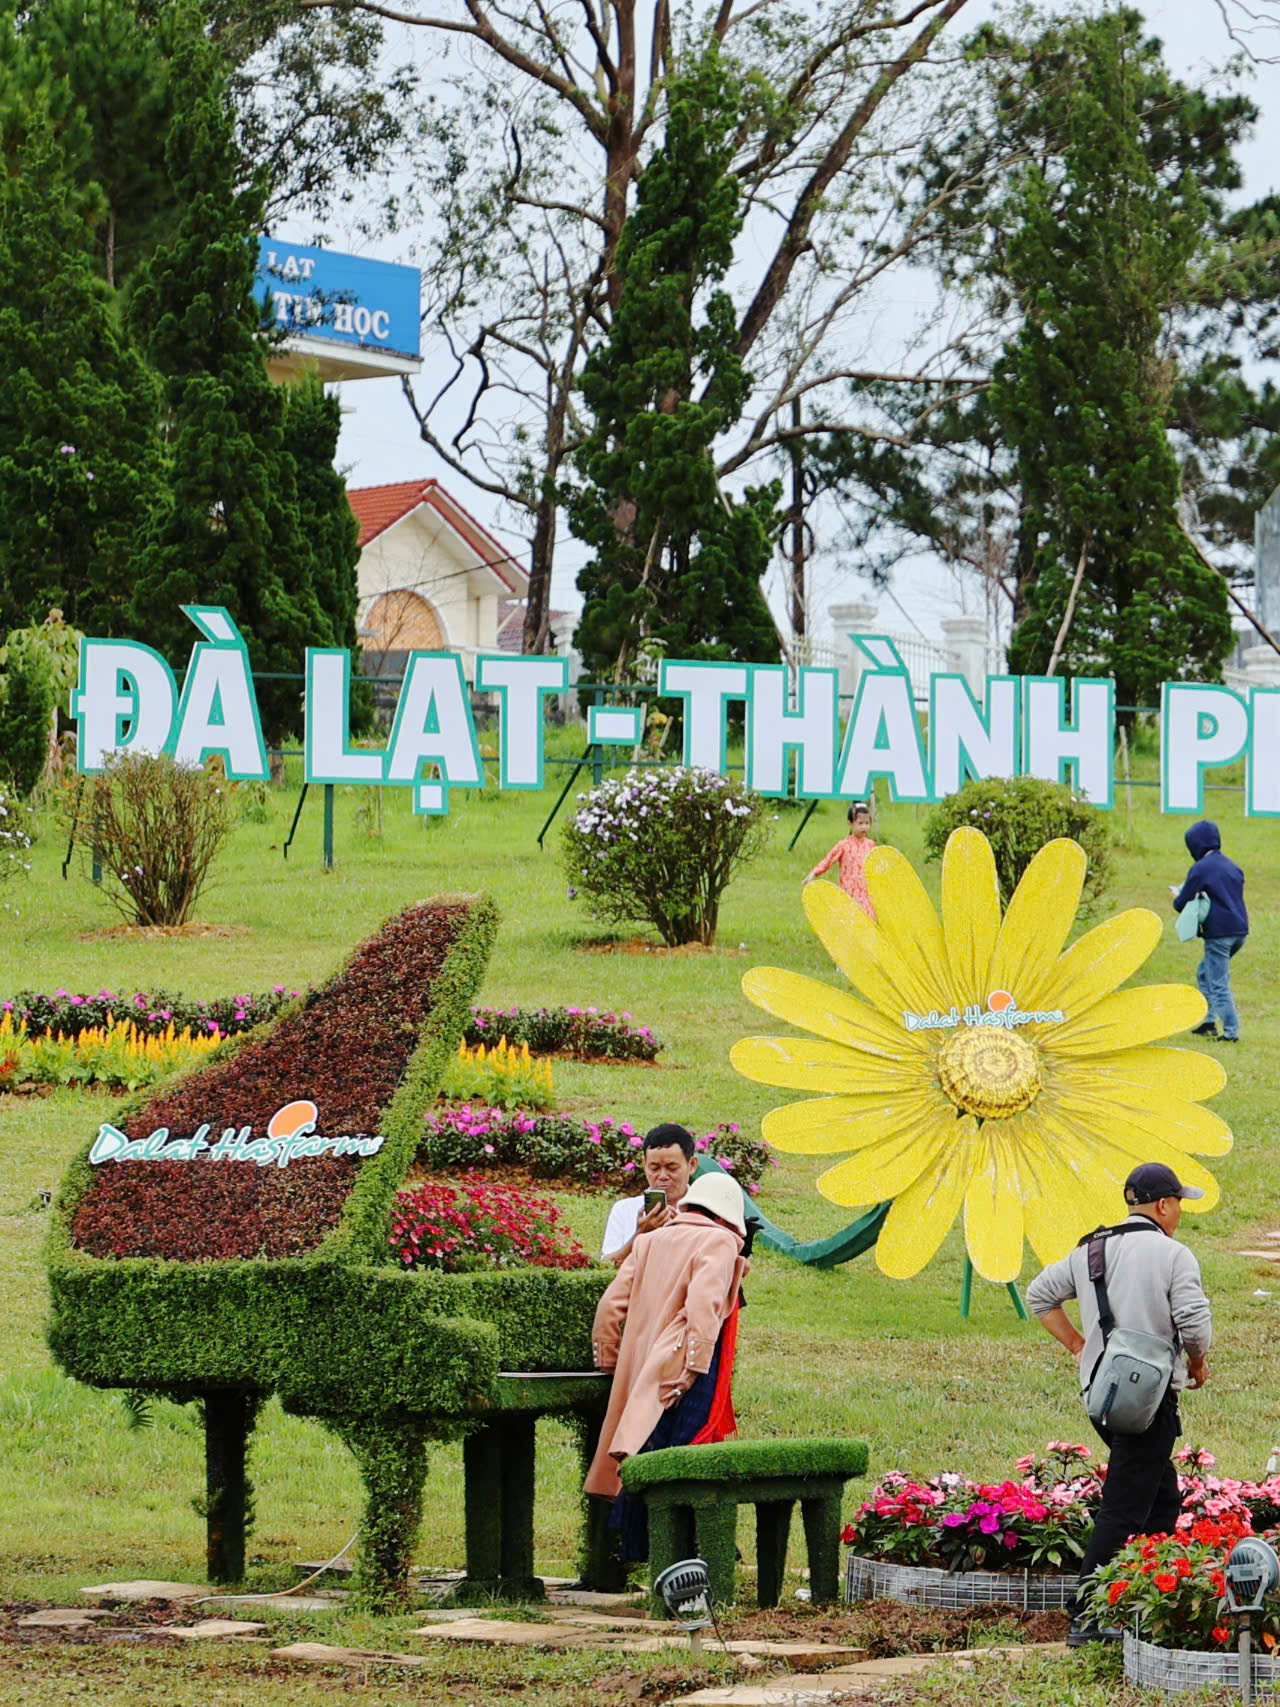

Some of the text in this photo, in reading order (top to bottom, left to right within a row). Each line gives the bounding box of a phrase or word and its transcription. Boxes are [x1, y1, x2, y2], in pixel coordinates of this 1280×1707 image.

[333, 302, 391, 346] HỌC
[70, 605, 270, 781] ĐÀ
[305, 647, 569, 815] LẠT
[658, 634, 1117, 810] THÀNH
[903, 1006, 960, 1031] Dalat
[90, 1123, 211, 1164] Dalat
